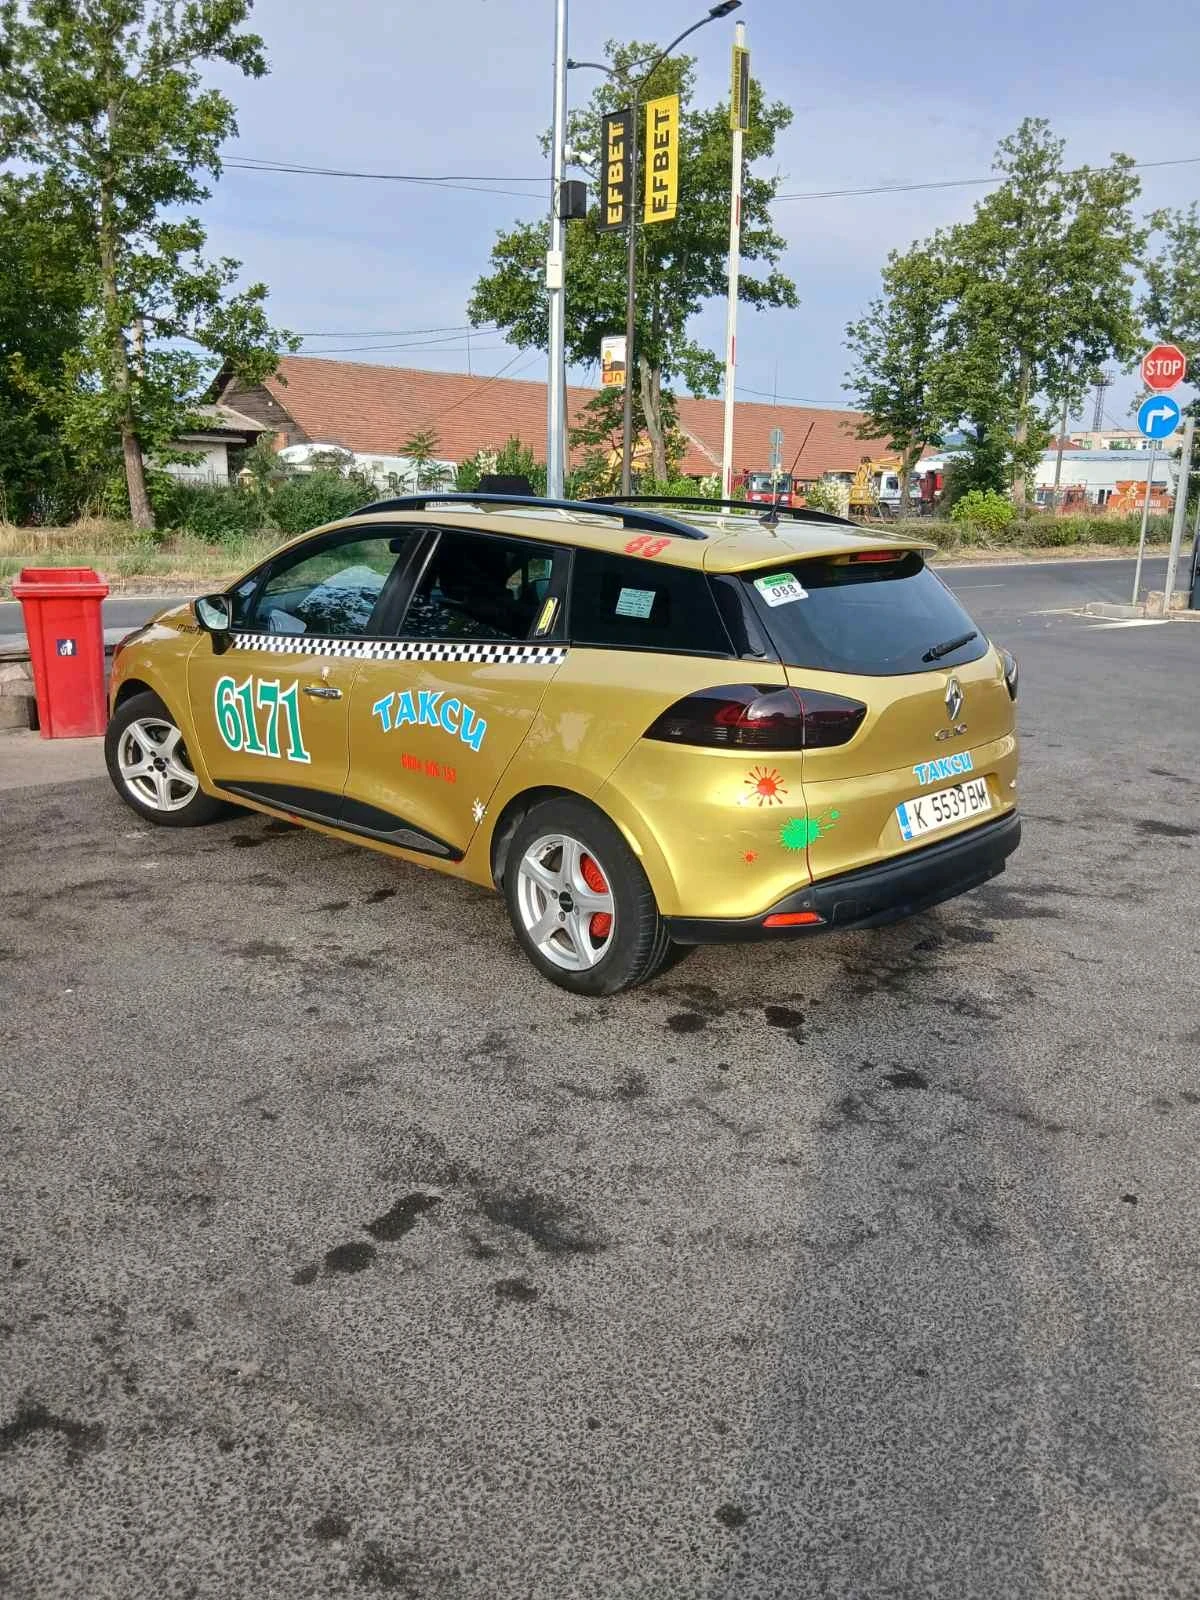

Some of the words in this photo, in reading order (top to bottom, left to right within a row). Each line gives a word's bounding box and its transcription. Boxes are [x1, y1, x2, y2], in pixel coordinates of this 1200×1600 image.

[606, 121, 625, 225] EFBET
[652, 108, 670, 214] EFBET
[1146, 359, 1181, 376] STOP
[772, 584, 797, 597] 088
[213, 674, 311, 765] 6171
[372, 689, 487, 752] ТАКСИ
[912, 751, 974, 785] ТАКСИ
[913, 801, 928, 829] K
[931, 789, 968, 822] 5539
